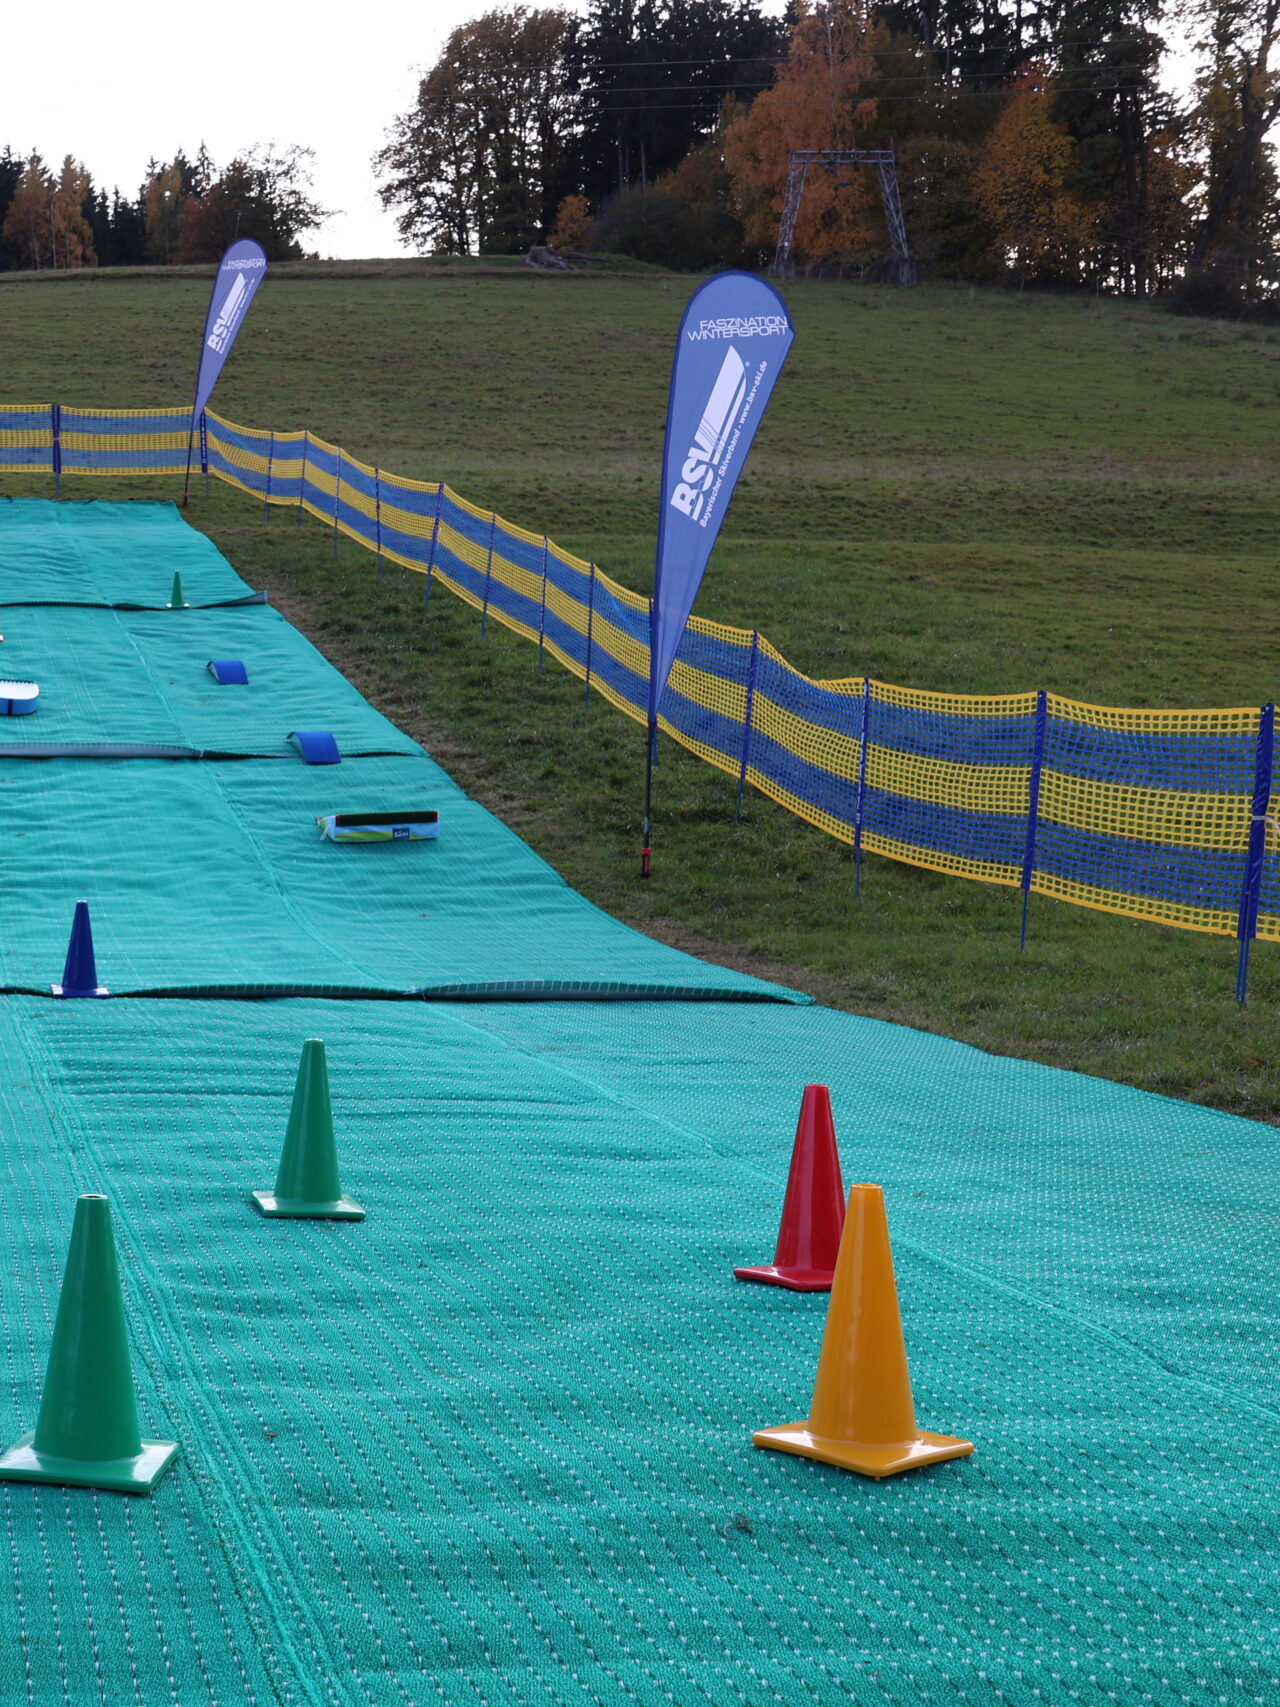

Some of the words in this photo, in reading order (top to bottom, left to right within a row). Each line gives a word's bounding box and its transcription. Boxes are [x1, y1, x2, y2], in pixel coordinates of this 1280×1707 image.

[700, 316, 788, 330] FASZINATION
[687, 325, 787, 341] WINTERSPORT
[699, 476, 722, 528] Bayerischer
[718, 428, 740, 477] Skiverband
